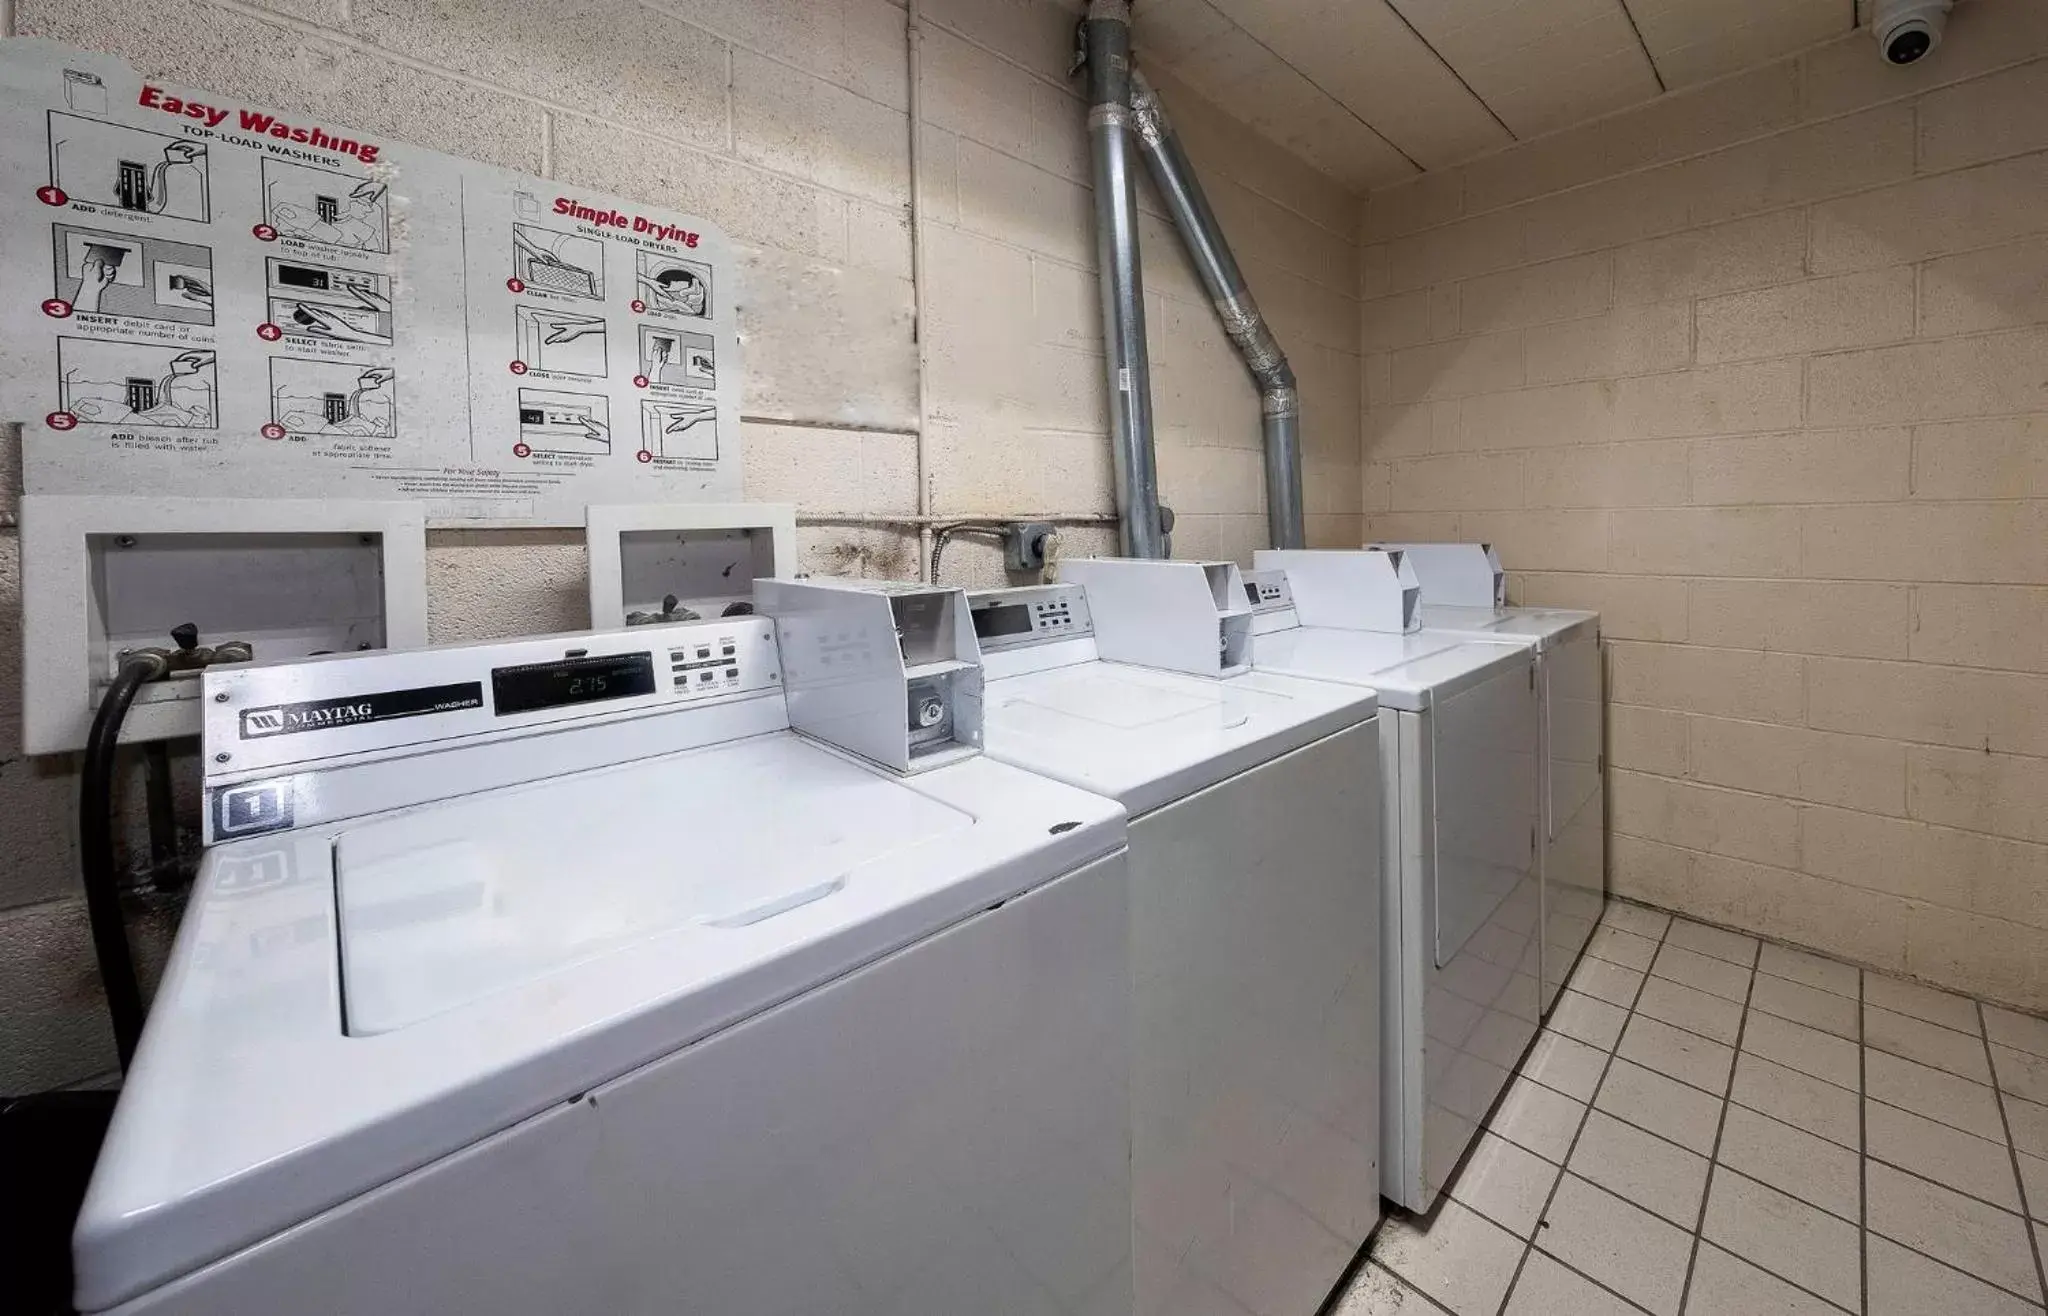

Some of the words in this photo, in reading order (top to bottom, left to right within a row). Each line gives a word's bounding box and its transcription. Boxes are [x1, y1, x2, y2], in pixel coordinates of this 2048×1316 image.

[138, 84, 229, 127] Easy
[240, 109, 380, 164] Washing
[181, 125, 262, 150] TOP-LOAD
[267, 144, 341, 168] WASHERS
[72, 203, 96, 214] ADD
[552, 197, 629, 229] Simple
[633, 216, 700, 249] Drying
[280, 239, 305, 249] LOAD
[577, 225, 640, 245] SINGLE-LOAD
[643, 239, 678, 253] DRYERS
[526, 290, 547, 298] CLEAN
[76, 314, 118, 325] INSERT
[123, 319, 150, 328] debit
[154, 323, 175, 332] card
[76, 323, 135, 336] appropriate
[138, 329, 174, 340] number
[178, 333, 189, 341] of
[285, 337, 318, 347] SELECT
[529, 371, 550, 379] CLOSE
[111, 433, 134, 441] ADD
[138, 434, 171, 443] bleach
[175, 436, 198, 444] after
[125, 442, 154, 450] filled
[156, 443, 176, 452] with
[333, 443, 356, 452] fabric
[323, 451, 371, 459] appropriate
[458, 468, 476, 476] Your
[477, 469, 500, 478] Safety
[433, 698, 479, 712] WASHER
[288, 703, 373, 725] MAYTAG
[244, 795, 261, 817] 1
